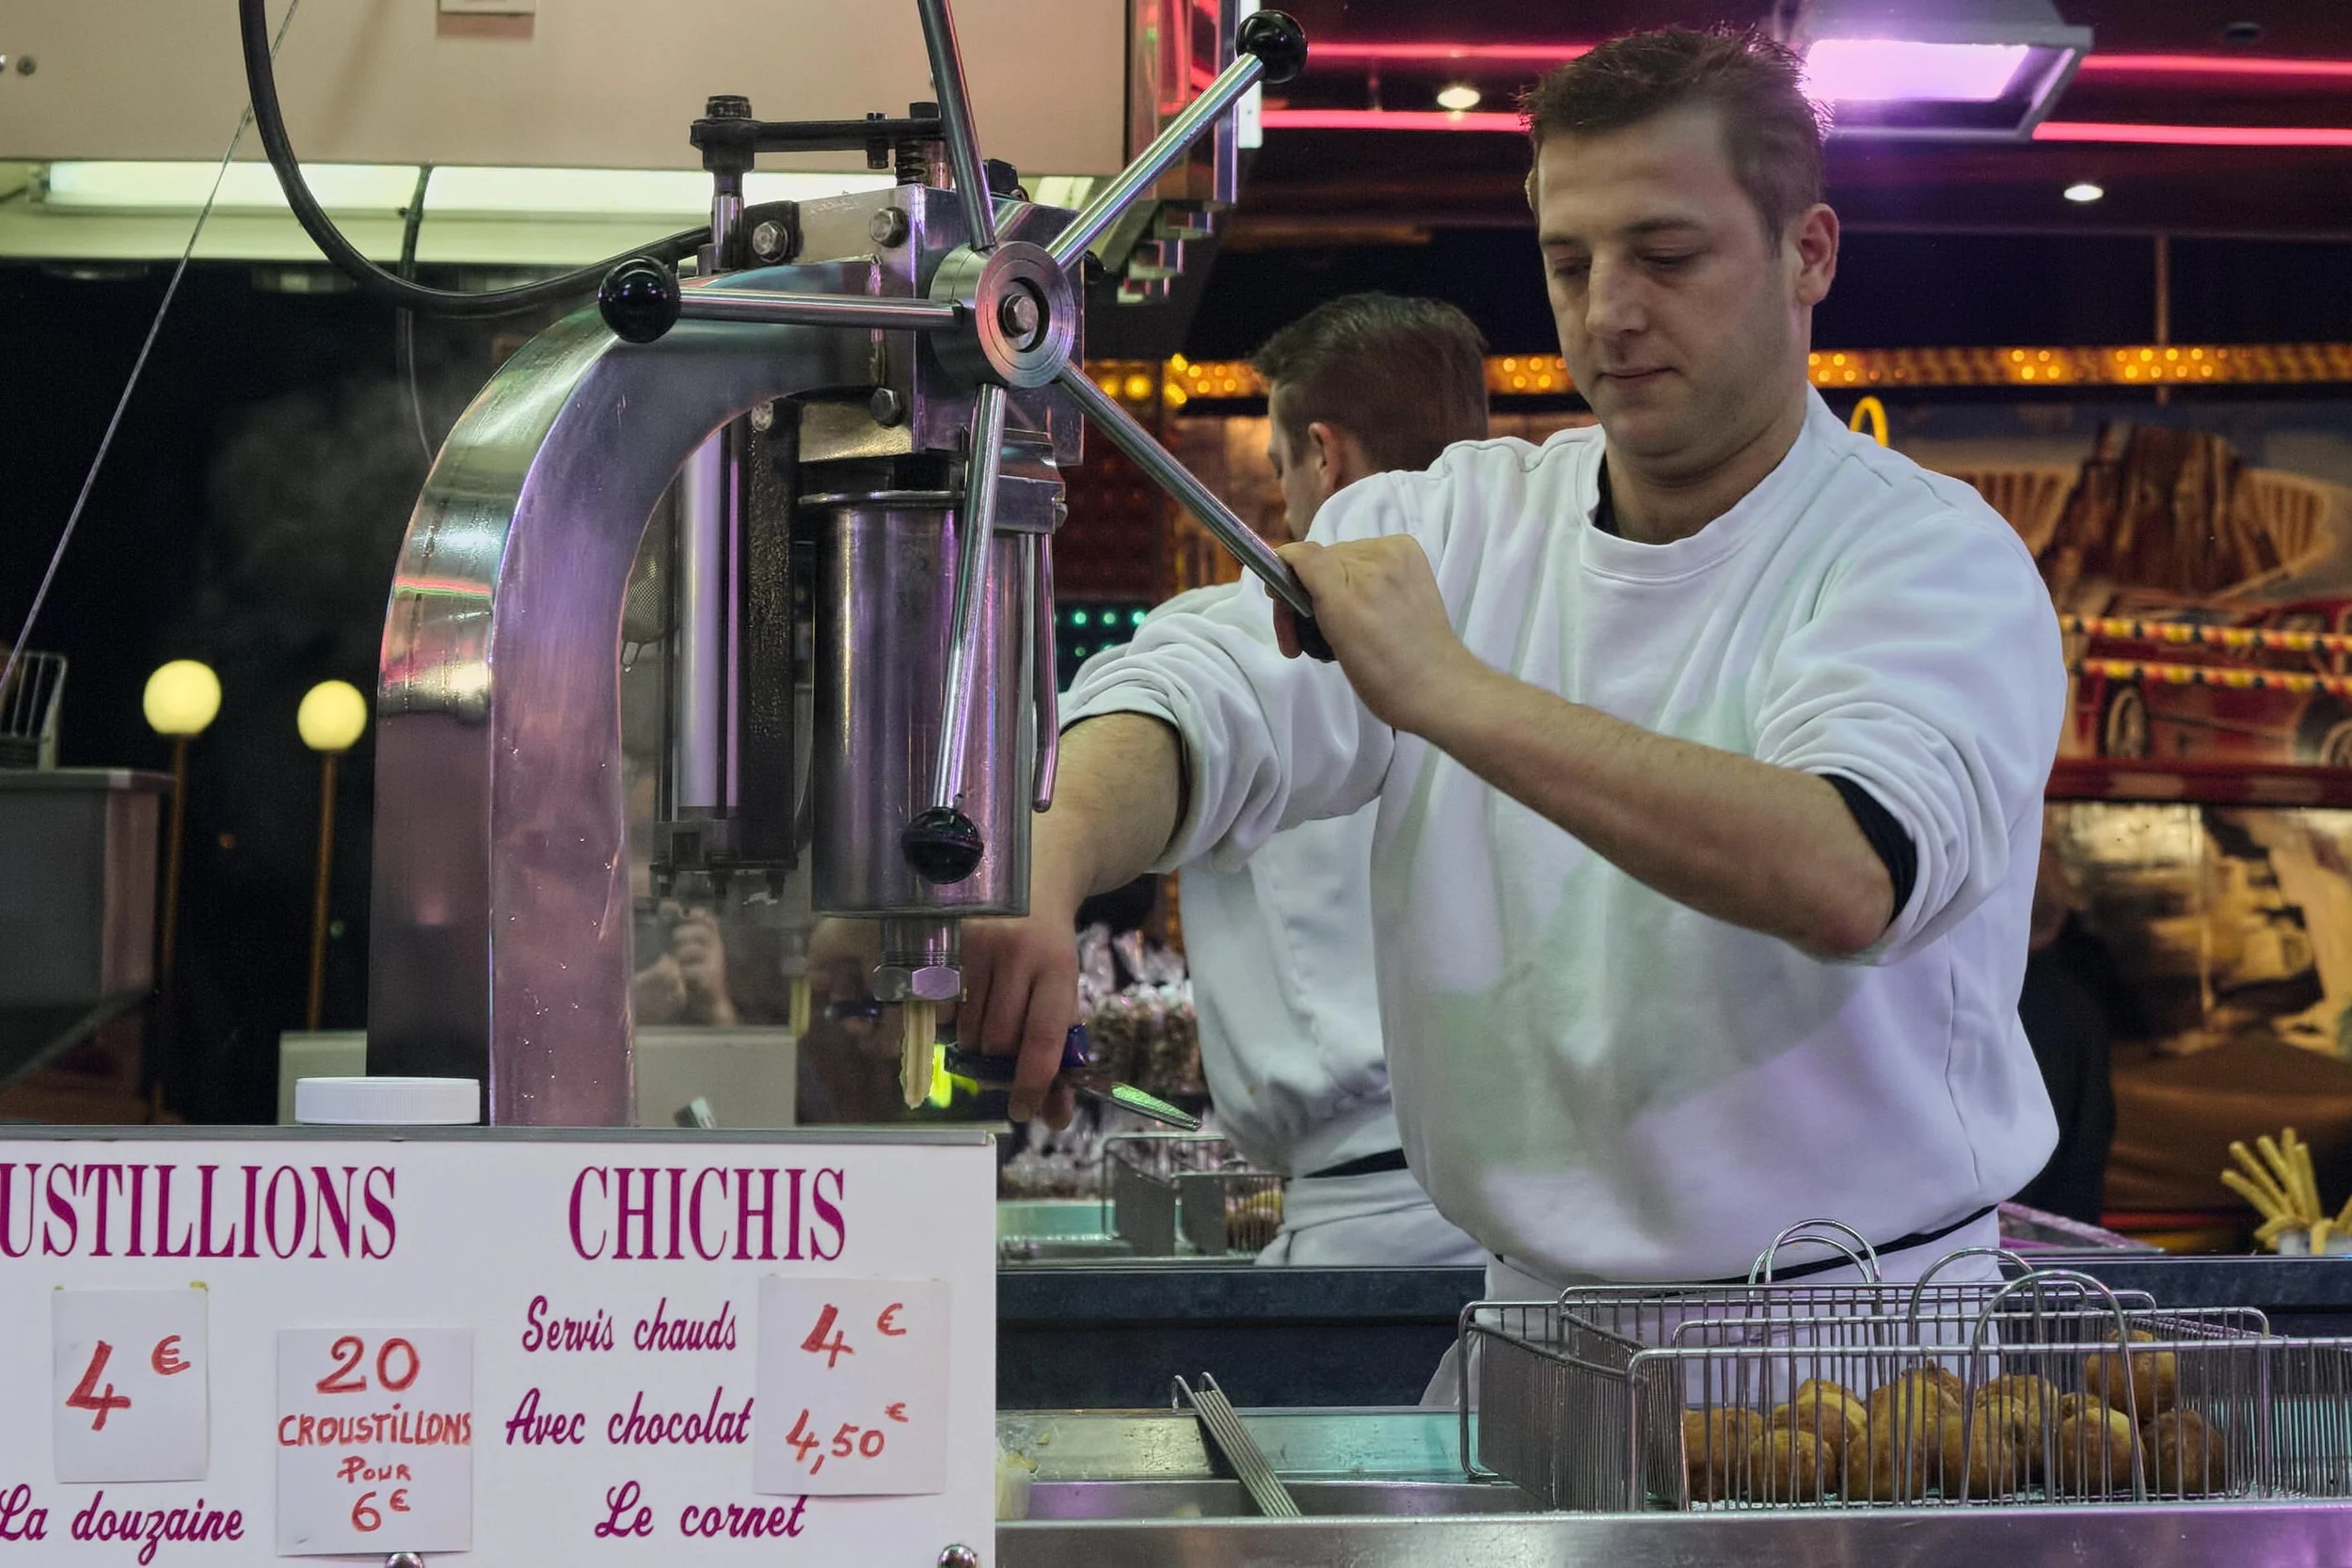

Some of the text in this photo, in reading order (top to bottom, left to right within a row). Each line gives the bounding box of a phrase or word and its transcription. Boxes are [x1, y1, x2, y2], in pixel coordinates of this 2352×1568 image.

[0, 1163, 397, 1260] USTILLIONS
[568, 1165, 846, 1262] CHICHIS
[522, 1294, 737, 1353] Servis chauds
[315, 1335, 421, 1395] 20
[504, 1386, 754, 1446] Avec chocolat
[0, 1483, 245, 1566] La douzaine
[593, 1480, 808, 1539] Le cornet
